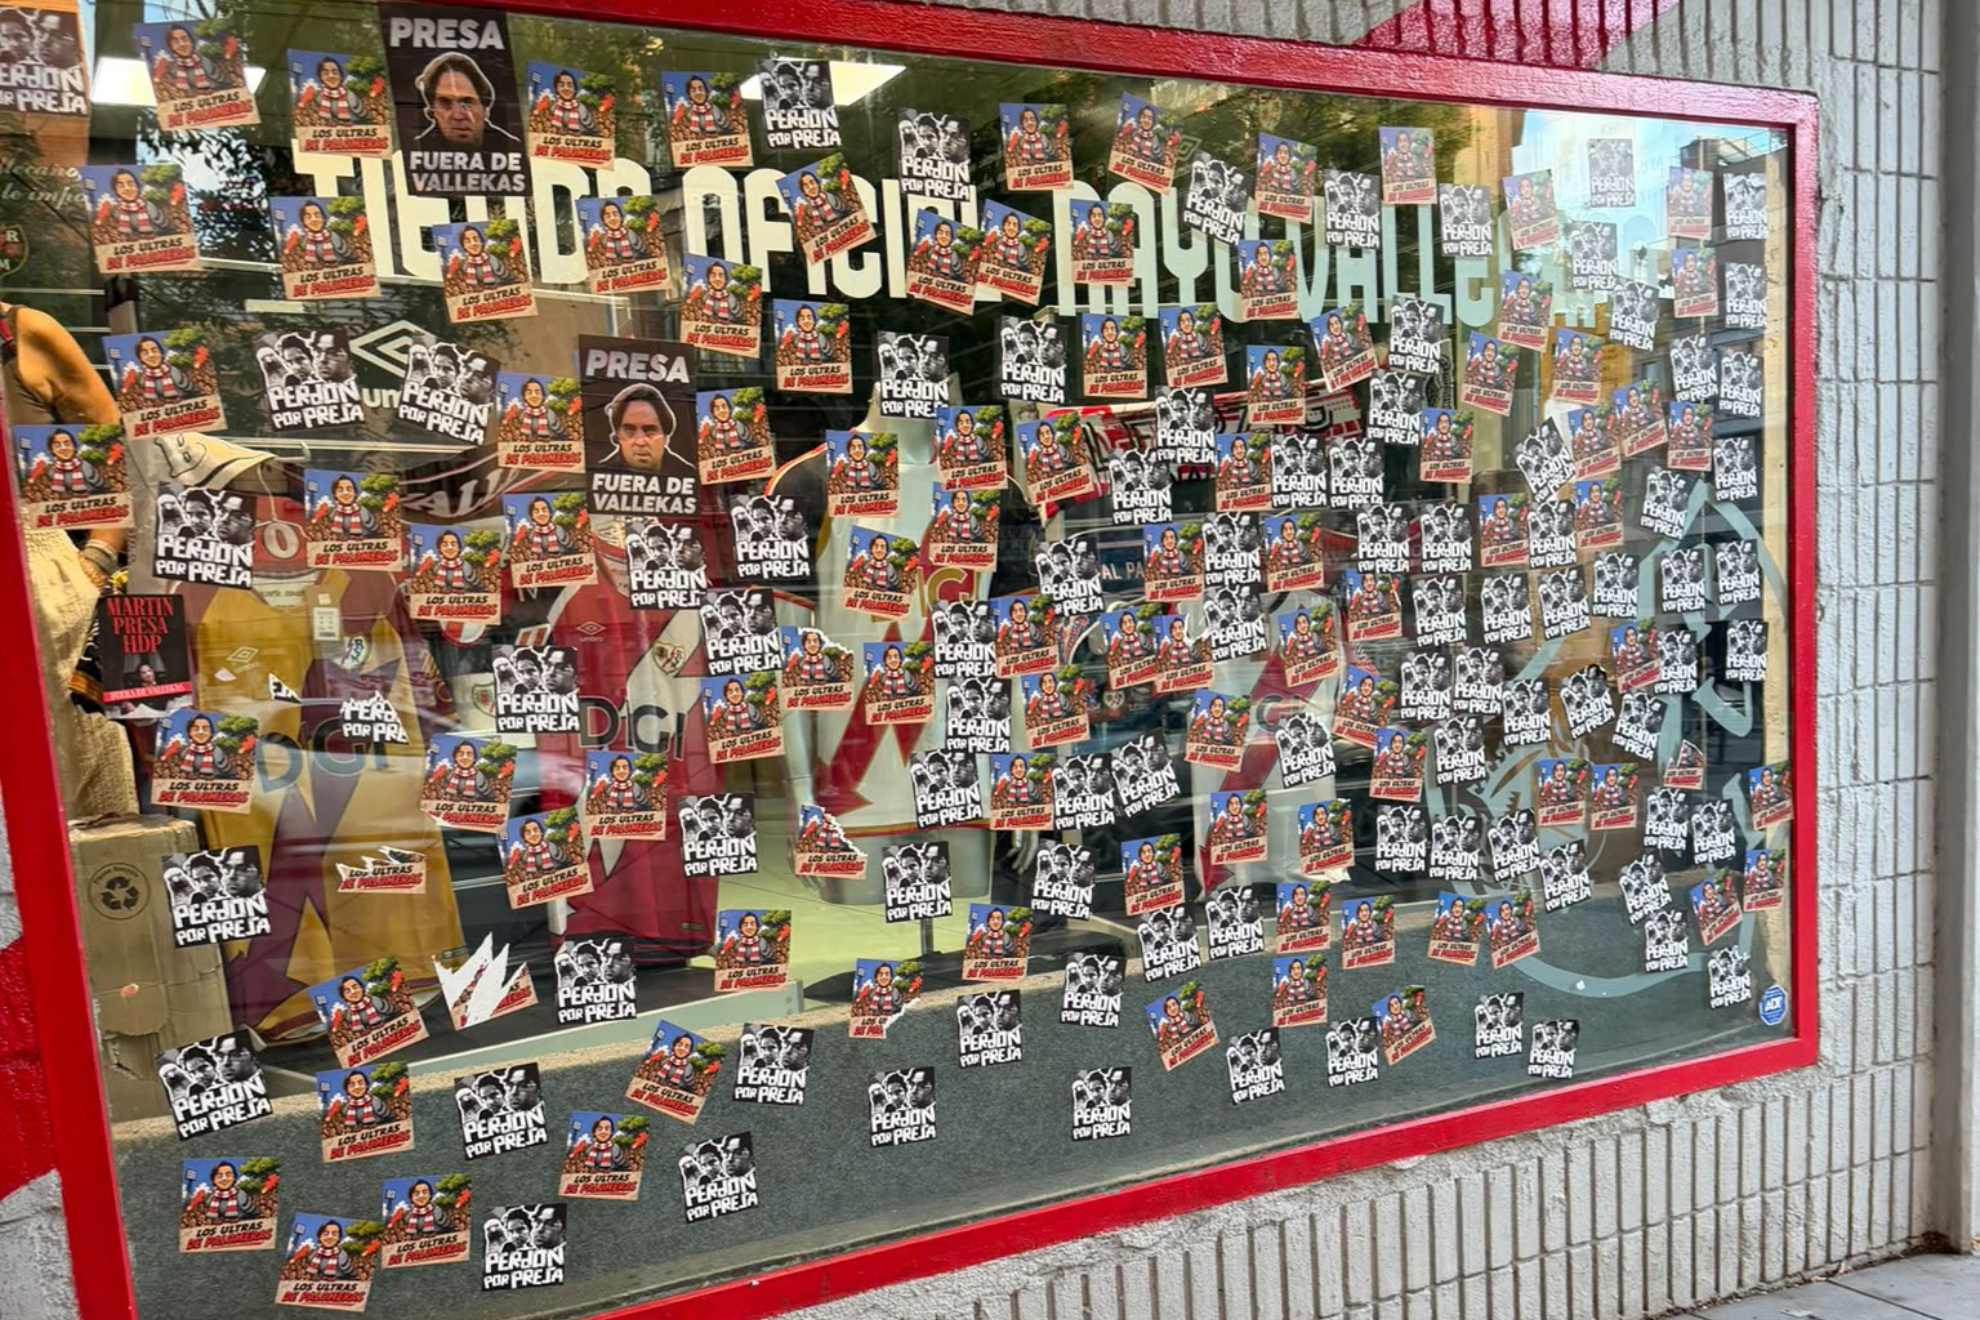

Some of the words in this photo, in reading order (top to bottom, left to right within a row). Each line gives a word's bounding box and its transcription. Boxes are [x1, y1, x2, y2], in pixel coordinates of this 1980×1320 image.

[389, 17, 505, 49] PRESA
[312, 129, 332, 138] LOS
[336, 128, 378, 138] ULTRAS
[410, 151, 485, 171] FUERA
[491, 152, 522, 171] DE
[1018, 167, 1032, 177] LOS
[1034, 163, 1063, 175] ULTRAS
[412, 173, 526, 192] VALLEKAS
[300, 272, 319, 283] LOS
[323, 266, 364, 280] ULTRAS
[585, 349, 690, 383] PRESA
[790, 367, 806, 376] LOS
[808, 365, 841, 375] ULTRAS
[1094, 374, 1108, 383] LOS
[1110, 372, 1138, 382] ULTRAS
[141, 409, 160, 422] LOS
[164, 398, 207, 417] ULTRAS
[272, 412, 302, 429] POR
[513, 444, 531, 453] LOS
[534, 443, 573, 453] ULTRAS
[592, 473, 660, 493] FUERA
[666, 477, 695, 494] DE
[593, 494, 697, 514] VALLEKAS
[156, 559, 186, 575] POR
[106, 597, 174, 616] MARTIN
[425, 596, 445, 605] LOS
[448, 595, 489, 604] ULTRAS
[113, 617, 168, 635] PRESA
[123, 635, 162, 654] HDP
[498, 716, 524, 731] POR
[721, 738, 737, 749] LOS
[740, 729, 773, 745] ULTRAS
[169, 782, 191, 791] LOS
[194, 782, 240, 791] ULTRAS
[598, 815, 616, 825] LOS
[618, 813, 656, 823] ULTRAS
[974, 960, 989, 968] LOS
[989, 959, 1020, 968] ULTRAS
[178, 1117, 209, 1138] POR
[573, 1175, 592, 1183] LOS
[594, 1173, 631, 1183] ULTRAS
[196, 1226, 217, 1238] LOS
[220, 1221, 264, 1235] ULTRAS
[483, 1274, 509, 1289] POR
